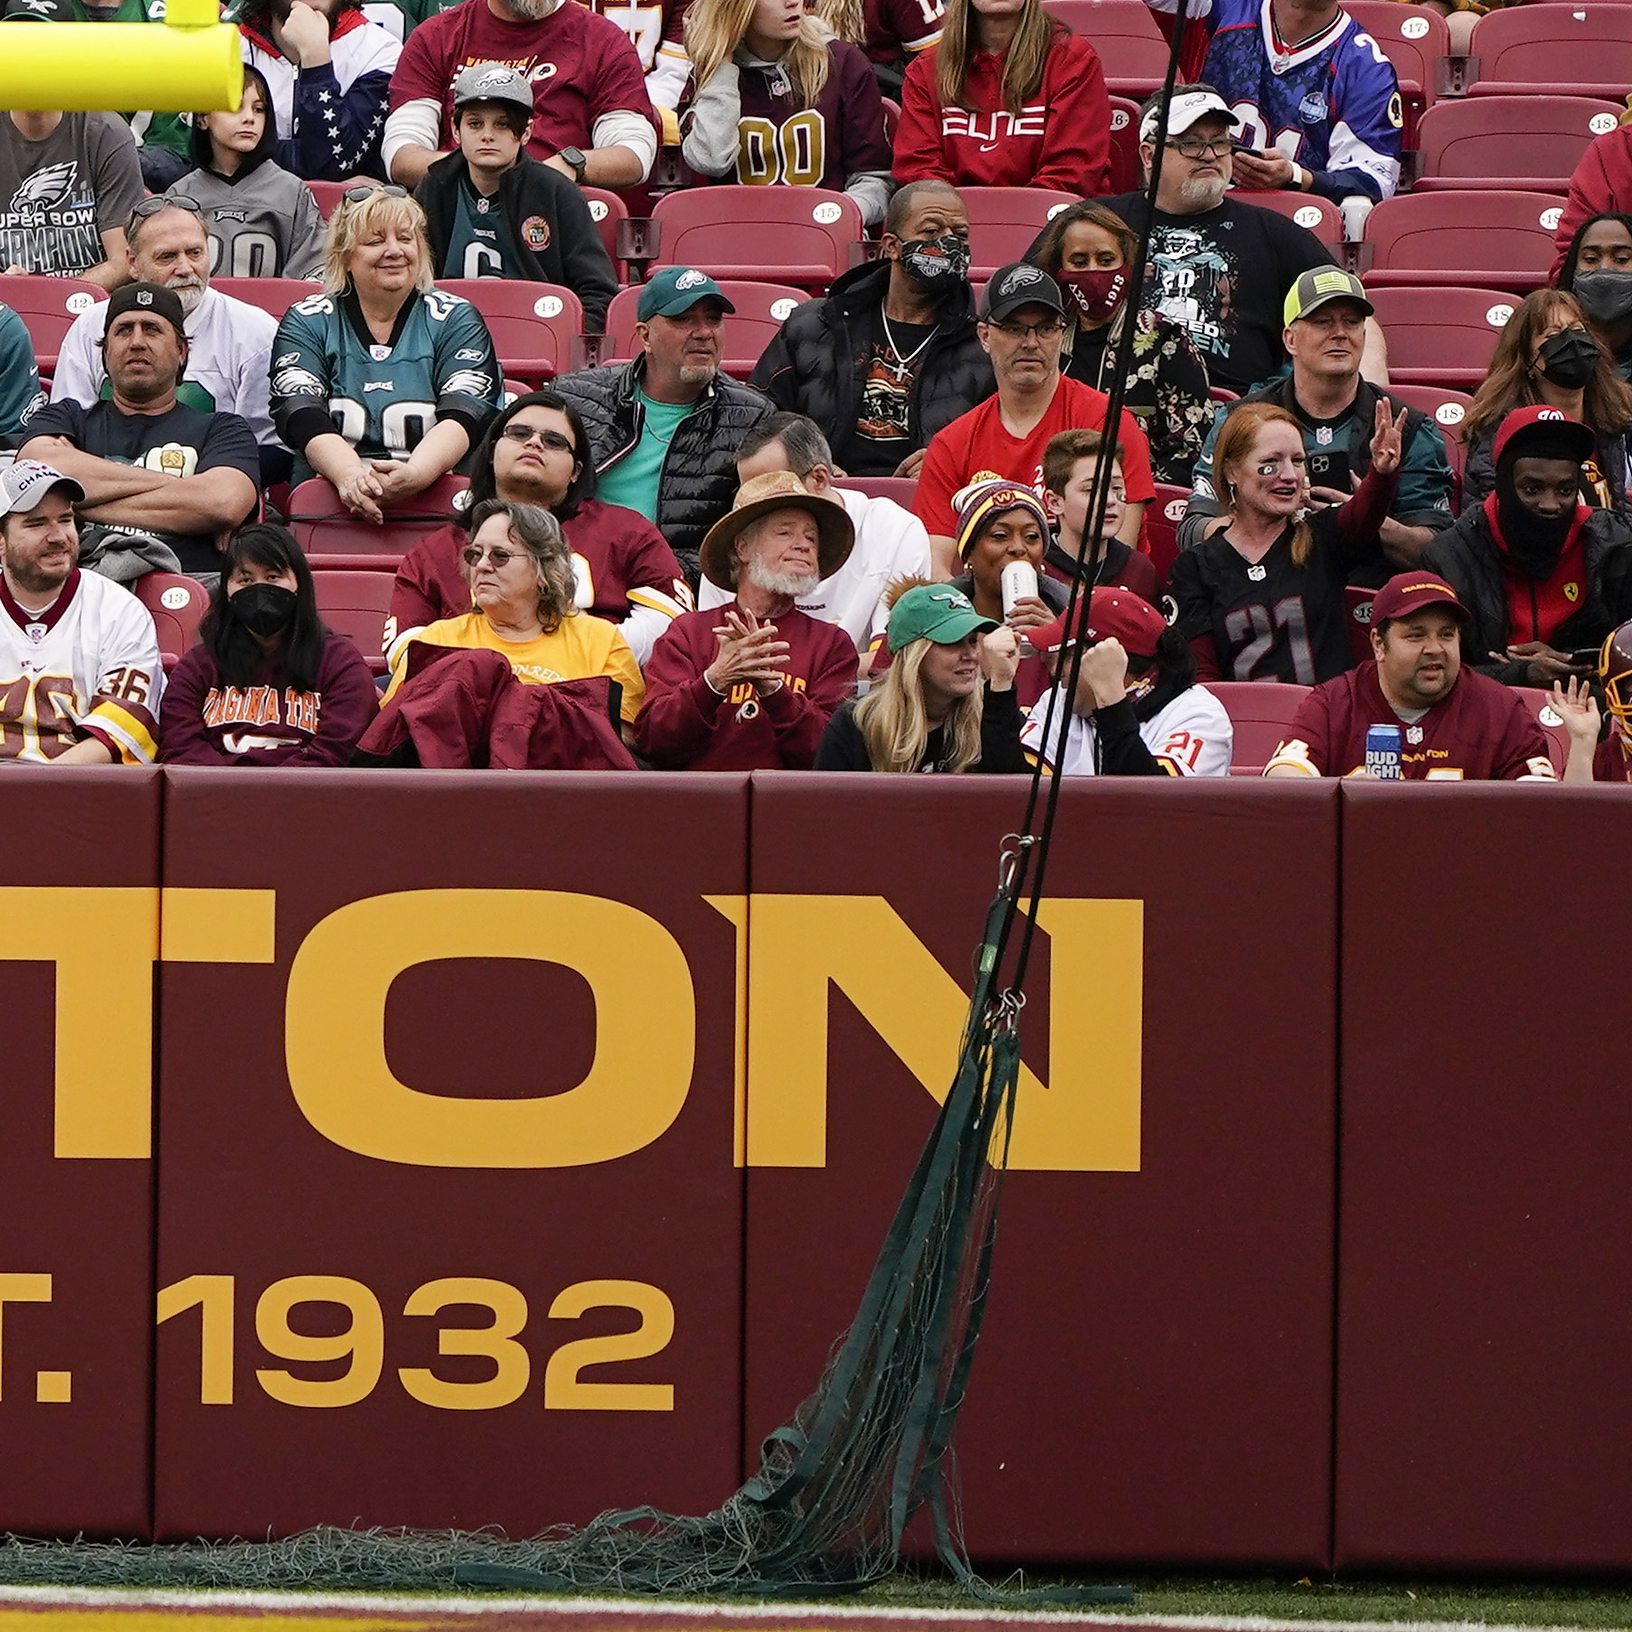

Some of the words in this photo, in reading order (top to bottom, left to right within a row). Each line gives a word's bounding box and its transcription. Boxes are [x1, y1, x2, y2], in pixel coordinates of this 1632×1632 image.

[1408, 21, 1423, 35] 17
[1597, 117, 1614, 133] 18
[735, 110, 826, 187] 00
[820, 206, 836, 220] 15
[1302, 210, 1316, 223] 17
[1105, 275, 1125, 307] 1913
[72, 297, 88, 310] 12
[542, 299, 556, 313] 14
[1494, 309, 1509, 323] 18
[1443, 407, 1458, 422] 18
[168, 591, 184, 606] 13
[1227, 596, 1314, 684] 21
[105, 667, 150, 706] 36
[1165, 730, 1202, 767] 21
[1366, 750, 1398, 766] BUD
[157, 1274, 675, 1412] 1932
